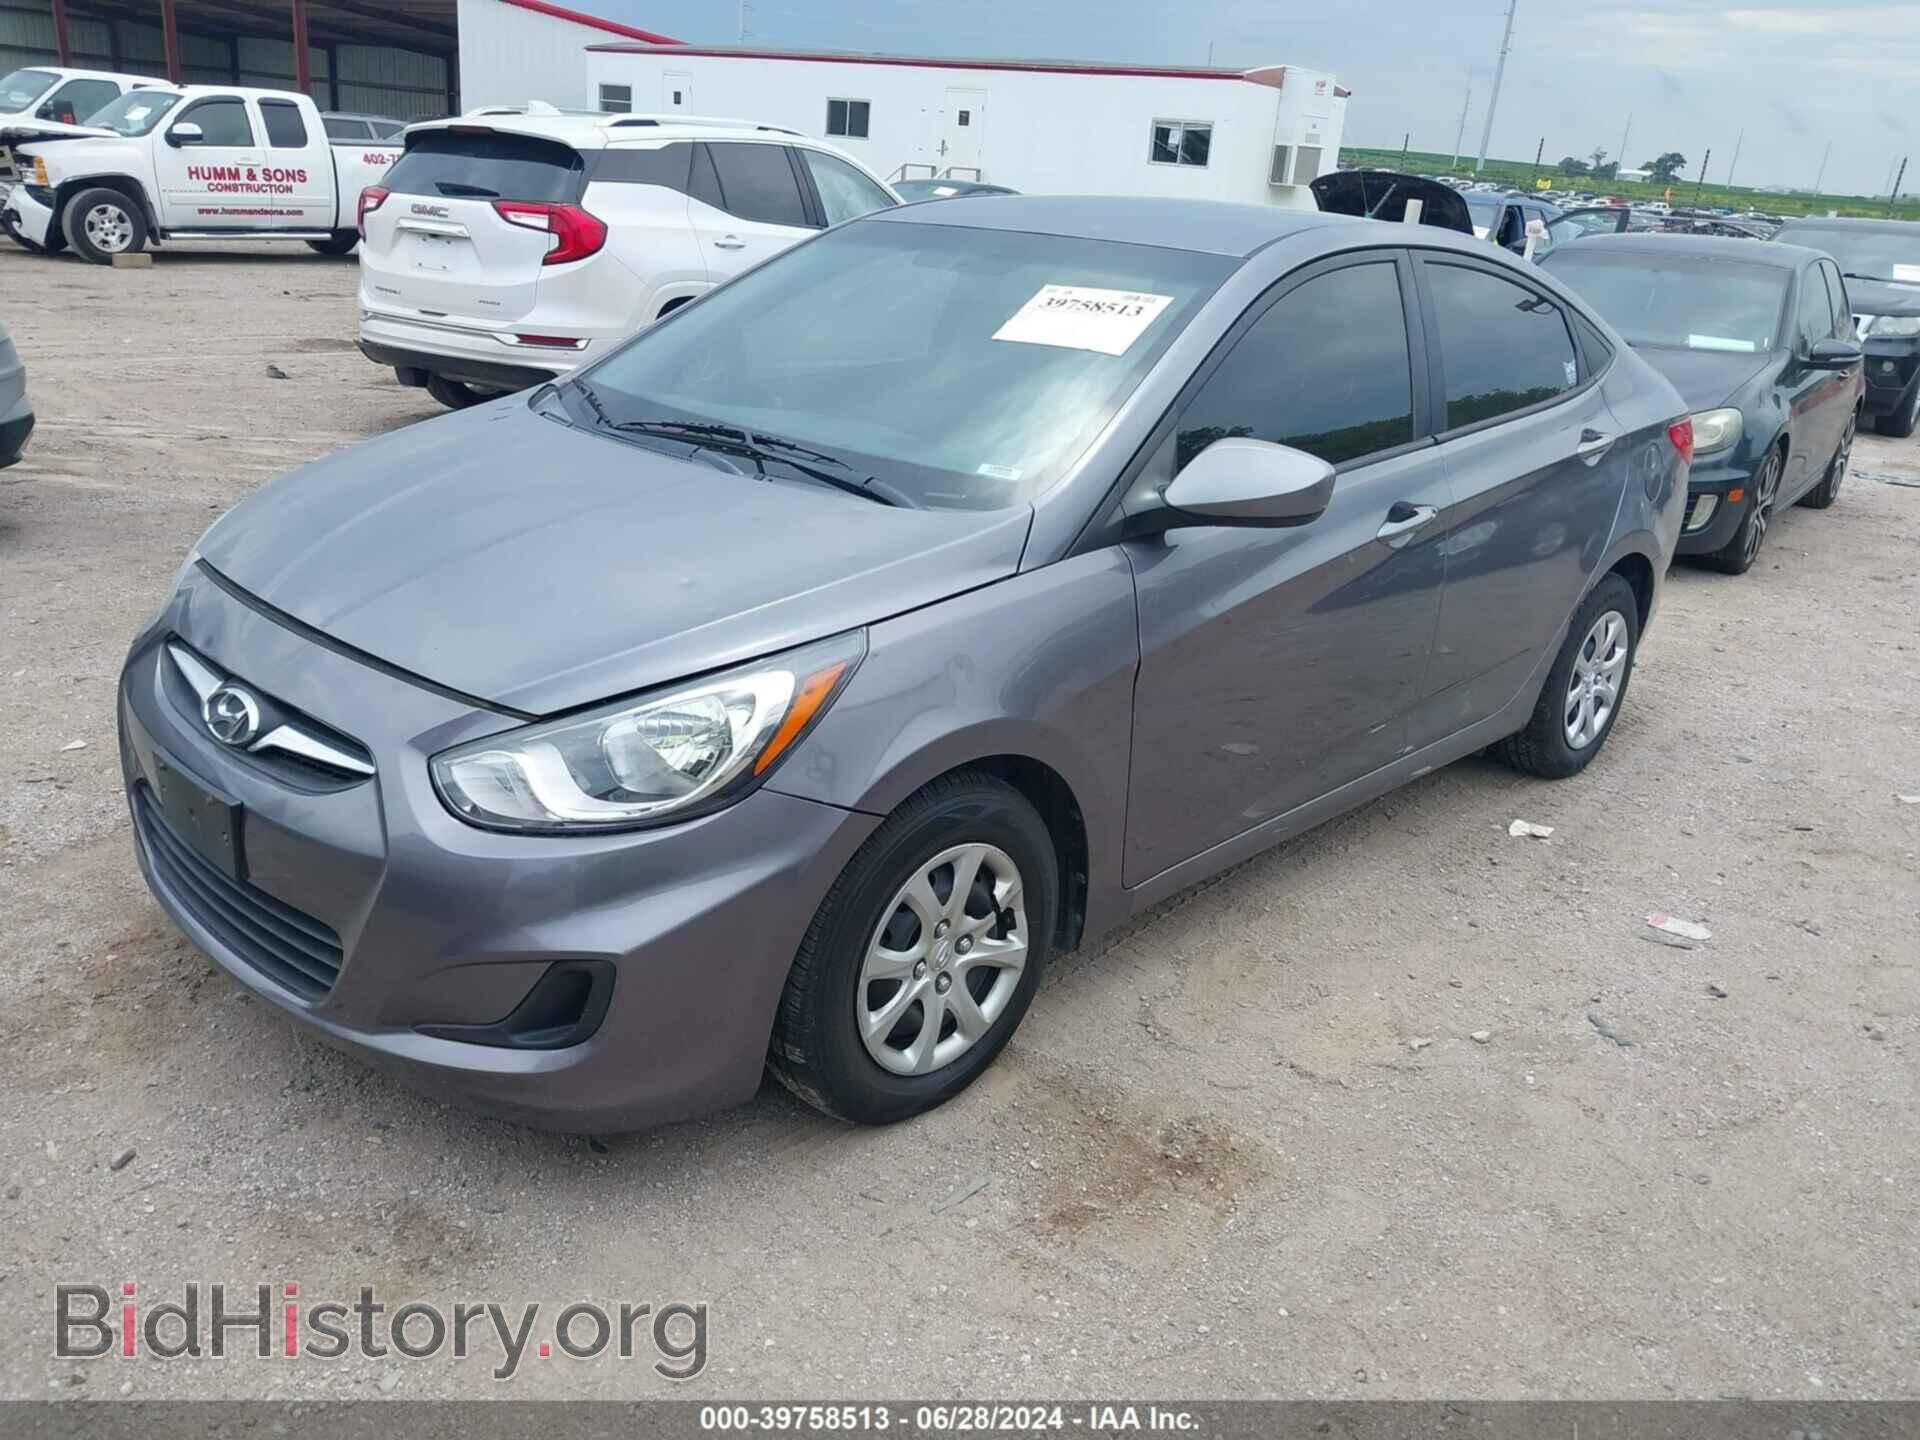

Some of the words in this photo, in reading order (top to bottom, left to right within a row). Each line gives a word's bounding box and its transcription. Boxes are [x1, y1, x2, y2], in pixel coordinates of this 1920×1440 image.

[187, 166, 241, 181] HUMM
[246, 169, 257, 181] &
[262, 168, 307, 183] SONS
[207, 182, 294, 194] CONSTRUCTION
[411, 204, 450, 218] GMC
[1039, 297, 1145, 317] 39758513
